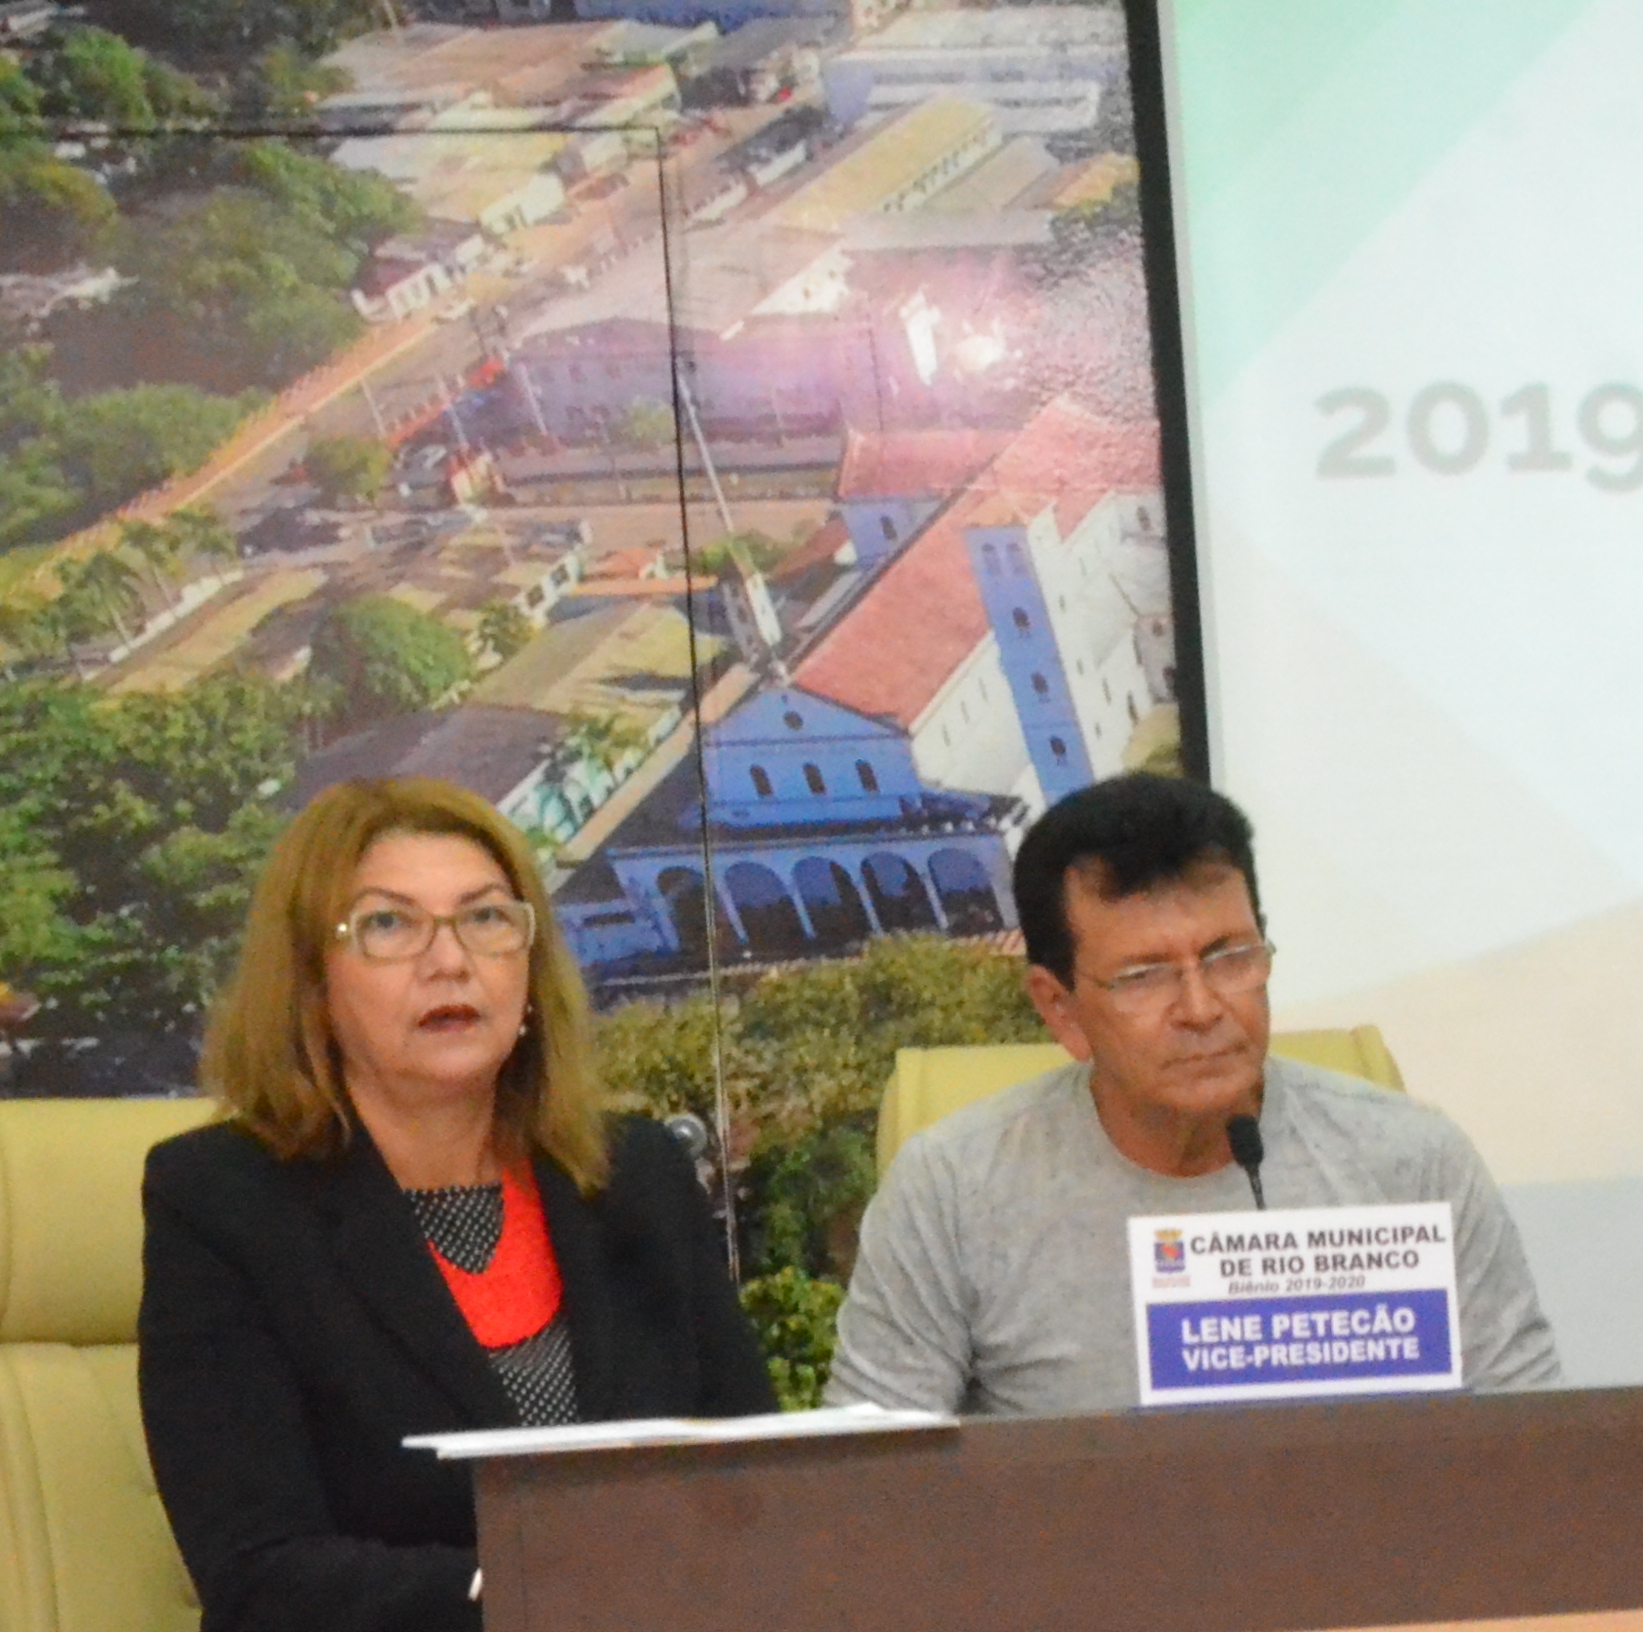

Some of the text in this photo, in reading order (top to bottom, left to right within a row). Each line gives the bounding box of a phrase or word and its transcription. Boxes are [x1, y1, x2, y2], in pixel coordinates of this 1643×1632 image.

[1190, 1224, 1446, 1254] CÂMARA MUNICIPAL
[1220, 1250, 1420, 1278] DE RIO BRANCO
[1182, 1303, 1416, 1343] LENE PETECÃO
[1182, 1337, 1420, 1371] VICE-PRESIDENTE
